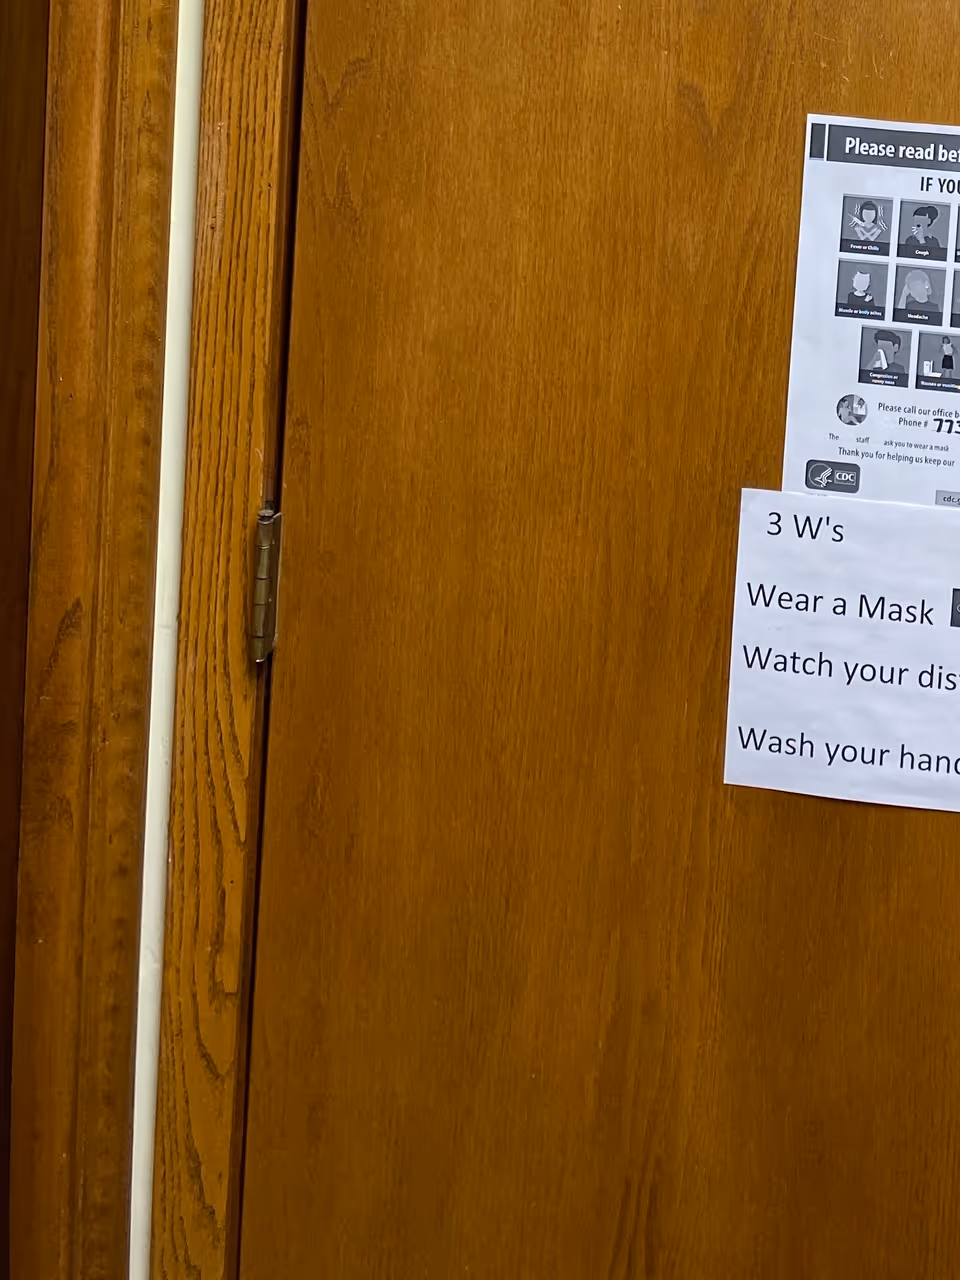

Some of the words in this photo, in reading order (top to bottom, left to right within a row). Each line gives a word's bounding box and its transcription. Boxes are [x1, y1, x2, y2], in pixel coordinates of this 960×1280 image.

[844, 136, 896, 157] Please
[899, 143, 935, 161] read
[919, 176, 933, 192] IF
[877, 402, 902, 413] Please
[903, 405, 917, 415] call
[932, 407, 953, 418] office
[898, 417, 922, 428] Phone
[828, 432, 840, 441] The
[855, 436, 870, 444] staff
[838, 446, 860, 457] Thank
[860, 449, 874, 459] you
[875, 450, 886, 460] for
[886, 451, 914, 465] helping
[914, 455, 924, 463] us
[924, 456, 942, 467] keep
[942, 459, 956, 467] our
[836, 472, 855, 482] CDC
[766, 511, 783, 536] 3
[793, 514, 845, 543] W's
[746, 582, 824, 614] Wear
[832, 597, 848, 617] a
[858, 593, 935, 626] Mask
[742, 644, 833, 678] Watch
[843, 658, 909, 686] your
[738, 725, 816, 759] Wash
[824, 739, 890, 767] your
